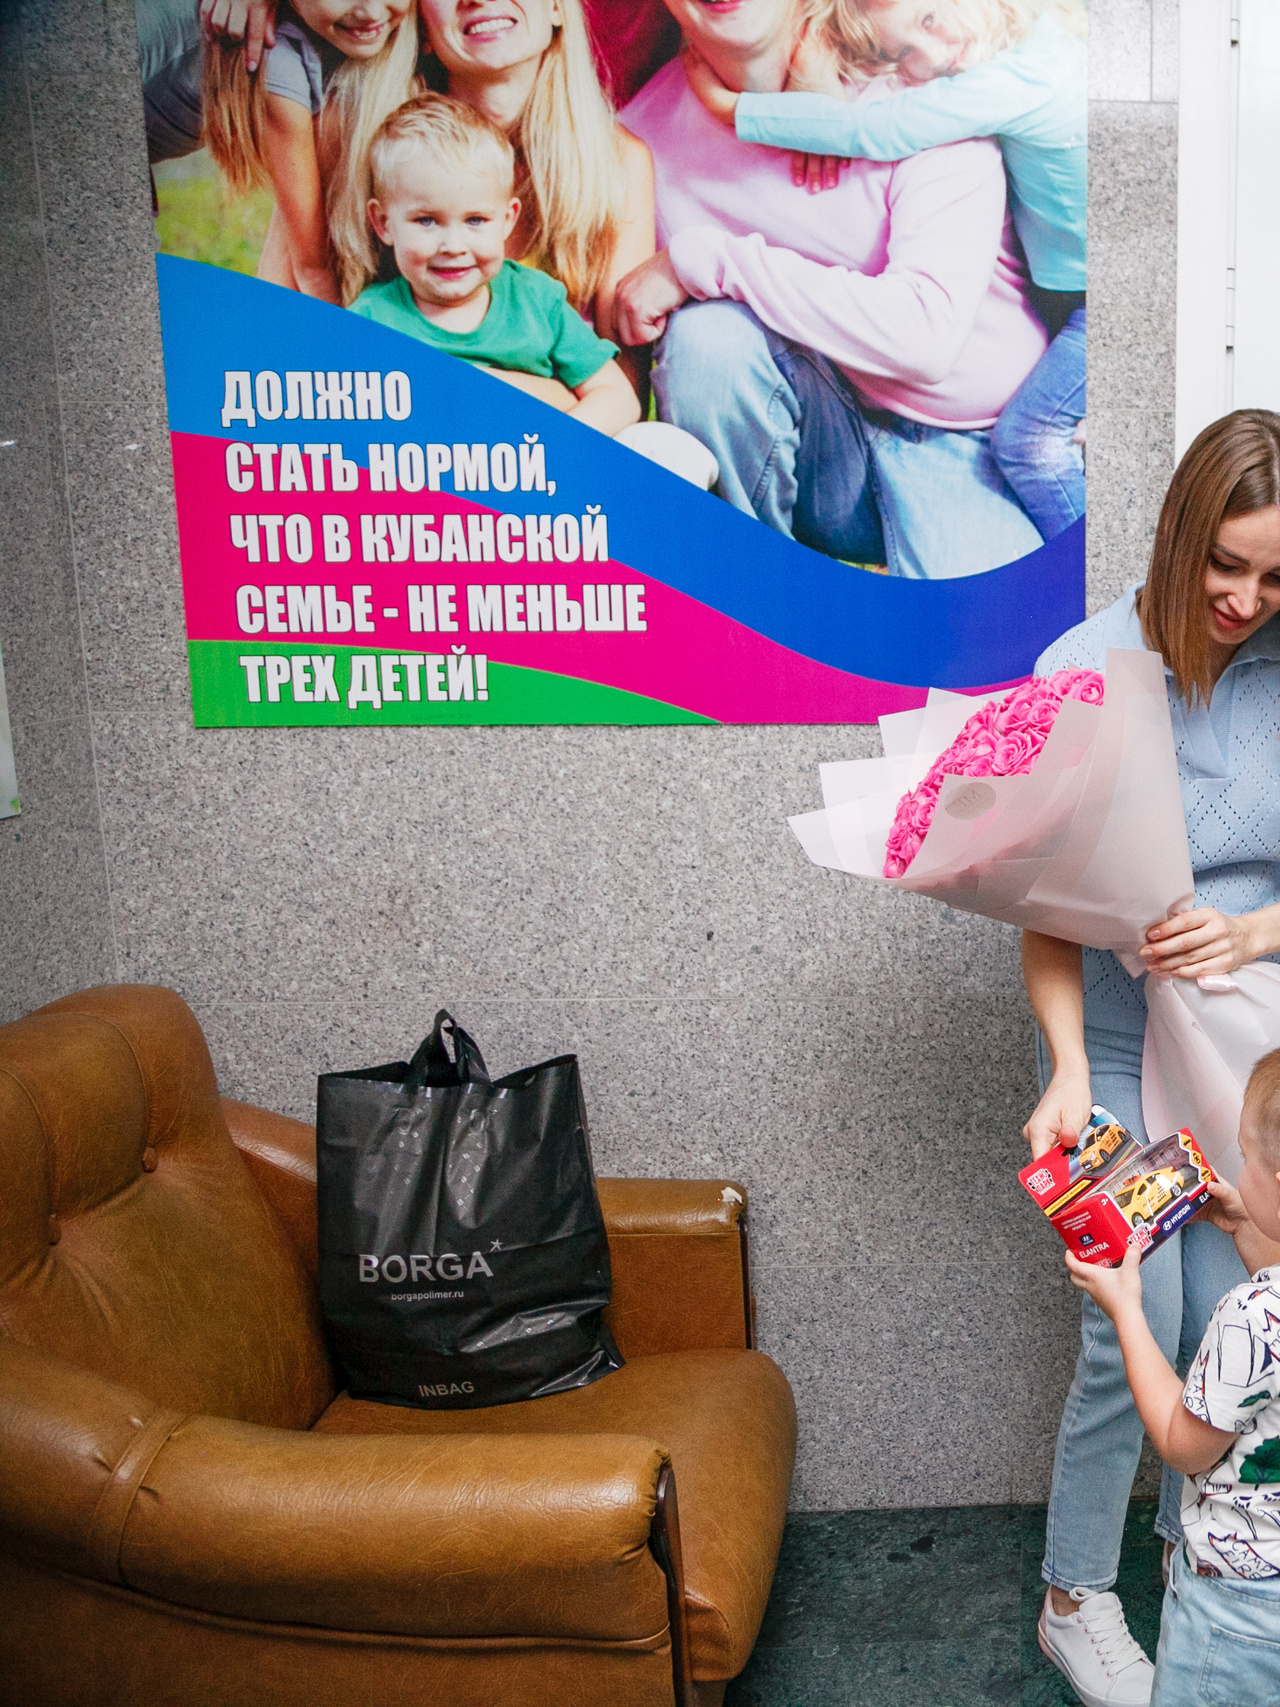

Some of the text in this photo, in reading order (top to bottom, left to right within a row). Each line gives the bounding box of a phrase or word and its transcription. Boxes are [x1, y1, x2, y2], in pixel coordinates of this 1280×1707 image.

[221, 370, 412, 429] ДОЛЖНО
[225, 433, 557, 497] СТАТЬ НОРМОЙ,
[229, 504, 609, 564] ЧТО В КУБАНСКОЙ
[236, 584, 376, 635] СЕМЬЕ
[407, 584, 459, 633] НЕ
[468, 584, 647, 633] МЕНЬШЕ
[239, 644, 489, 711] ТРЕХ ДЕТЕЙ!
[1170, 1204, 1191, 1225] HYUNDAI
[1079, 1241, 1110, 1259] ELANTRA
[359, 1251, 494, 1283] BORGA
[391, 1288, 464, 1301] borgapolimer.ru
[418, 1381, 474, 1397] INBAG
[1232, 1540, 1272, 1572] CAMP
